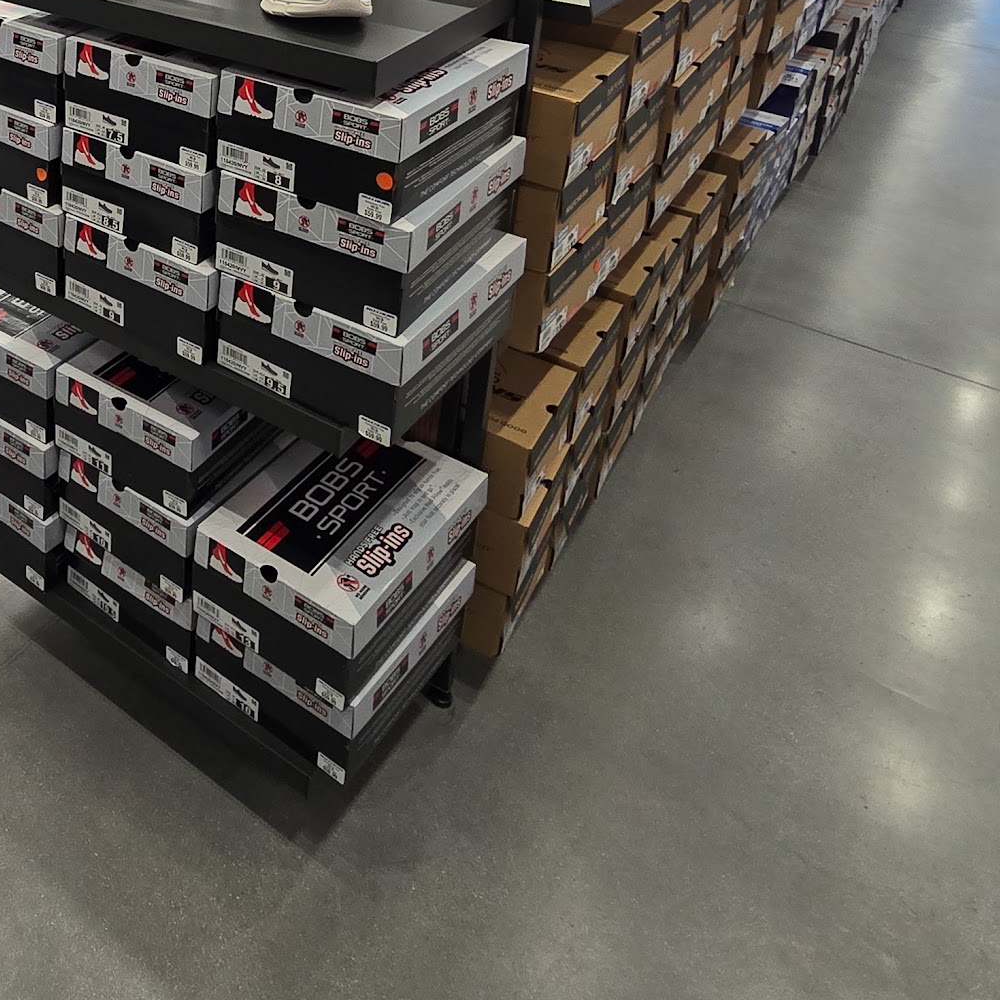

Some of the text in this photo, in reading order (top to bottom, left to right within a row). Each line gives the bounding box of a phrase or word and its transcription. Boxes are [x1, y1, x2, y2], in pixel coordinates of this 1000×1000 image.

[14, 49, 39, 64] Slip-ins
[487, 74, 513, 101] Slip-ins
[158, 88, 188, 106] Slip-ins
[342, 119, 369, 132] SPORT
[343, 113, 368, 126] BOBS
[429, 107, 450, 127] BOBS
[108, 129, 123, 143] 7.5
[429, 119, 450, 136] SPORT
[334, 130, 372, 150] Slip-ins
[275, 175, 282, 186] 8
[151, 182, 180, 201] Slip-ins
[102, 217, 118, 230] 8.5
[364, 209, 383, 221] $59.99
[347, 228, 374, 241] SPORT
[348, 222, 373, 236] BOBS
[339, 237, 377, 259] Slip-ins
[155, 276, 183, 296] Slip-ins
[273, 281, 280, 290] 9
[108, 310, 115, 320] 9
[370, 320, 388, 332] $59.99
[342, 330, 367, 344] BOBS
[333, 345, 369, 368] Slip-ins
[266, 377, 285, 394] 9.5
[144, 435, 172, 457] Slip-ins
[288, 458, 364, 522] BOBS
[319, 472, 384, 536] SPORT
[345, 525, 383, 566] HANDS FREE
[355, 523, 412, 576] Slip-ins
[296, 612, 328, 639] Slip-ins
[297, 691, 328, 717] Slip-ins
